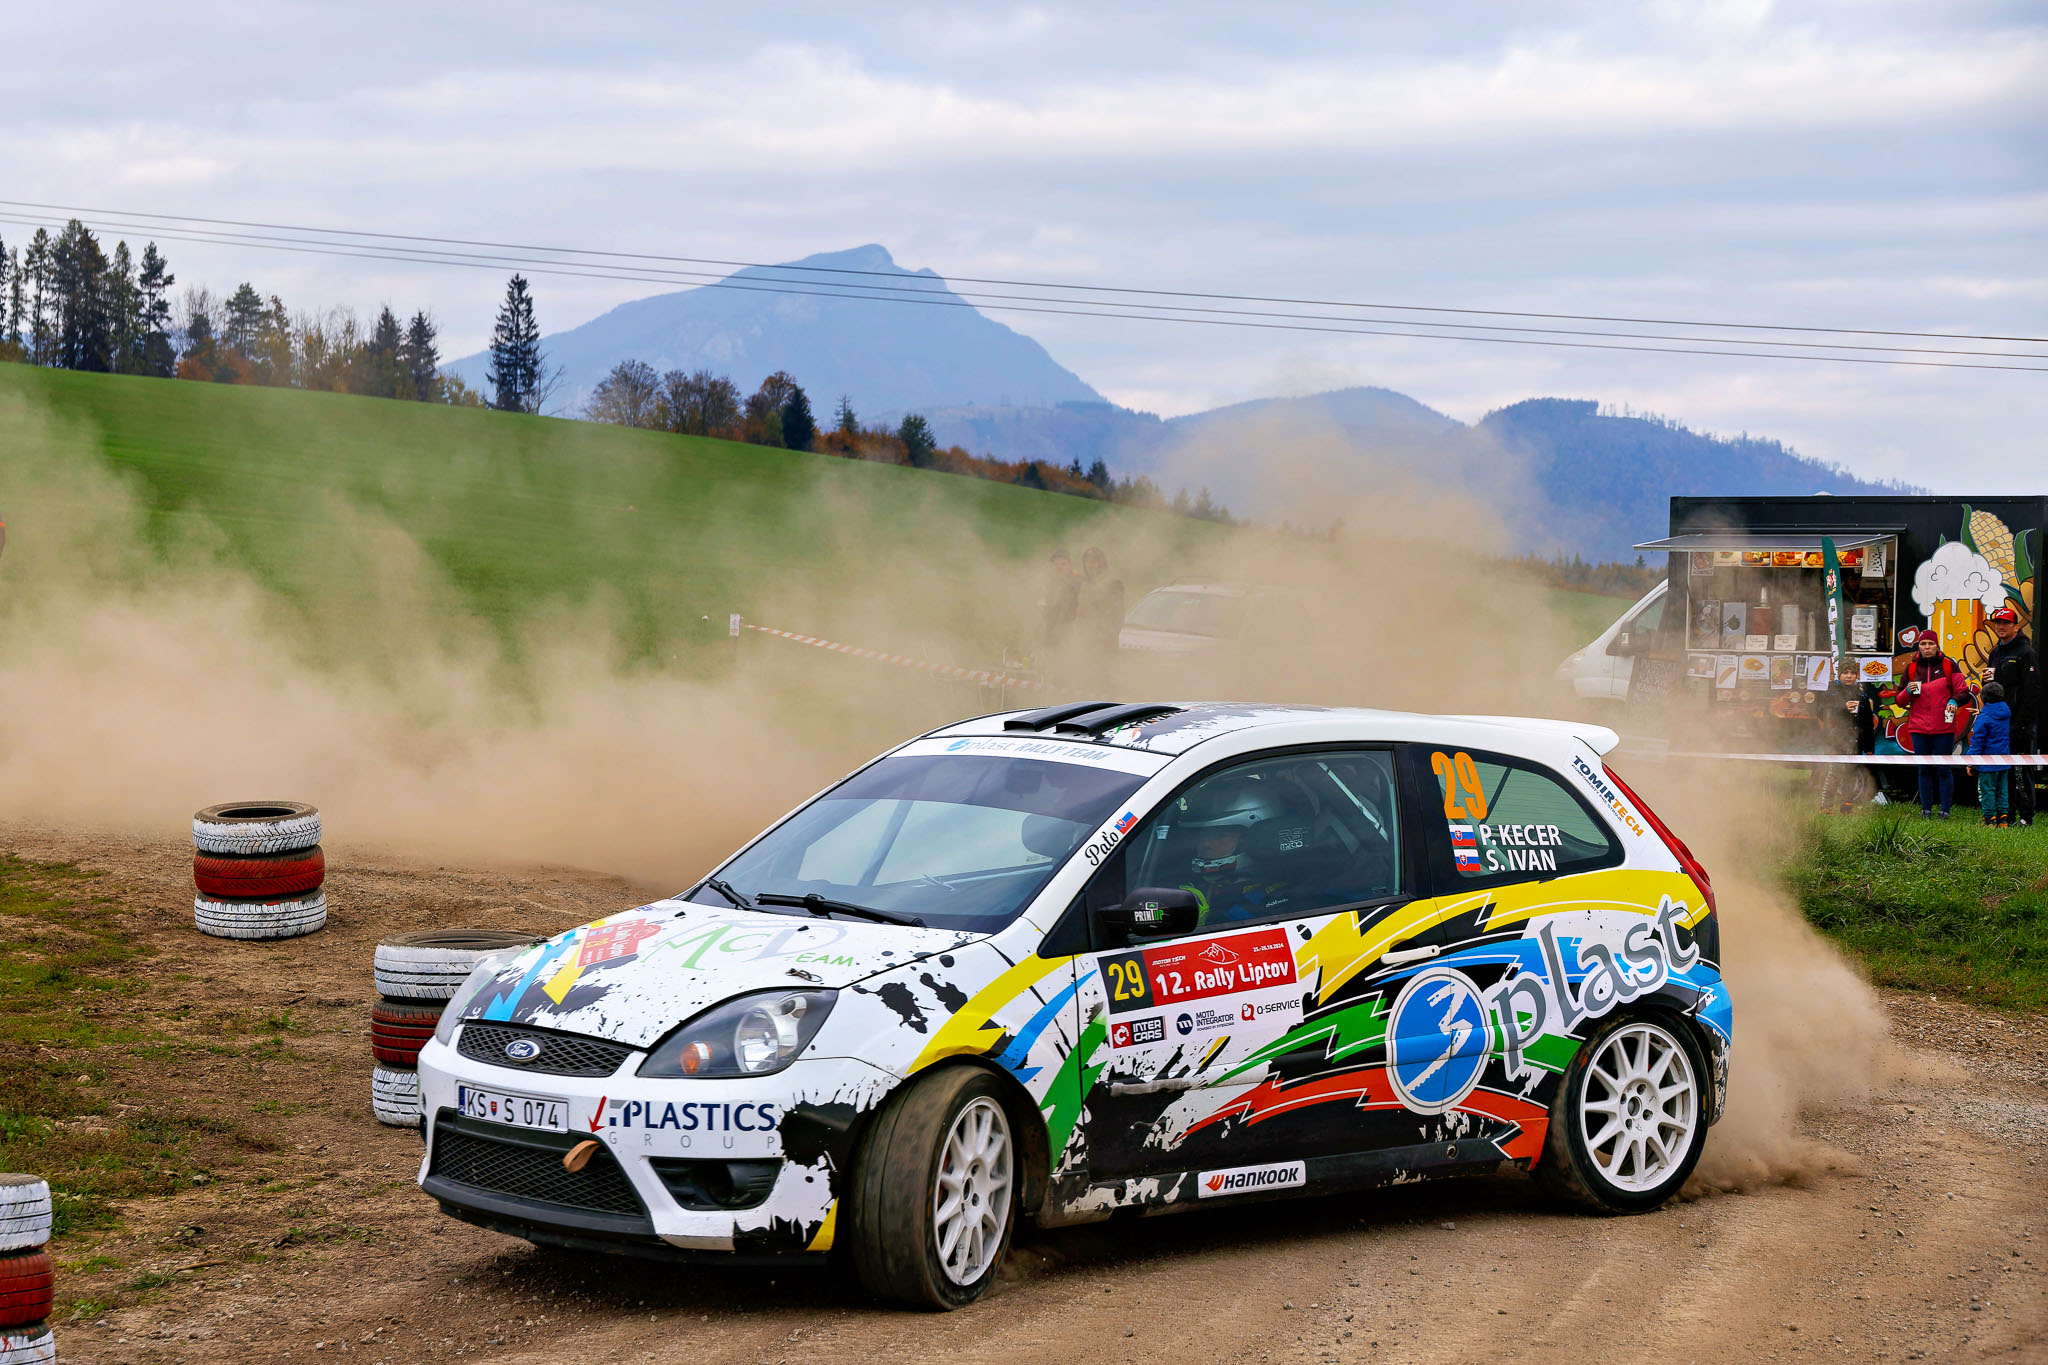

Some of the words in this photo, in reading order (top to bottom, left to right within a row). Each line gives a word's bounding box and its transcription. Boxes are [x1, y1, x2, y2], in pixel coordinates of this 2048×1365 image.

[1015, 743, 1068, 754] RALLY
[1062, 747, 1112, 760] TEAM
[1431, 752, 1488, 819] 29
[1573, 755, 1644, 837] TOMIRTECH
[1479, 824, 1497, 846] P.
[1498, 824, 1562, 846] KECER
[1486, 850, 1506, 871] S.
[1508, 850, 1557, 871] IVAN
[1108, 960, 1145, 1001] 29
[1155, 971, 1191, 996] 12.
[1194, 965, 1235, 991] Rally
[1238, 961, 1289, 985] Liptov
[1196, 1009, 1215, 1020] MOTO
[1196, 1013, 1235, 1027] INTEGRATOR
[1132, 1019, 1161, 1032] INTER
[1134, 1029, 1162, 1042] CARS
[467, 1090, 486, 1117] KS
[504, 1098, 514, 1123] S
[525, 1101, 558, 1128] 074
[609, 1131, 775, 1150] GROUP
